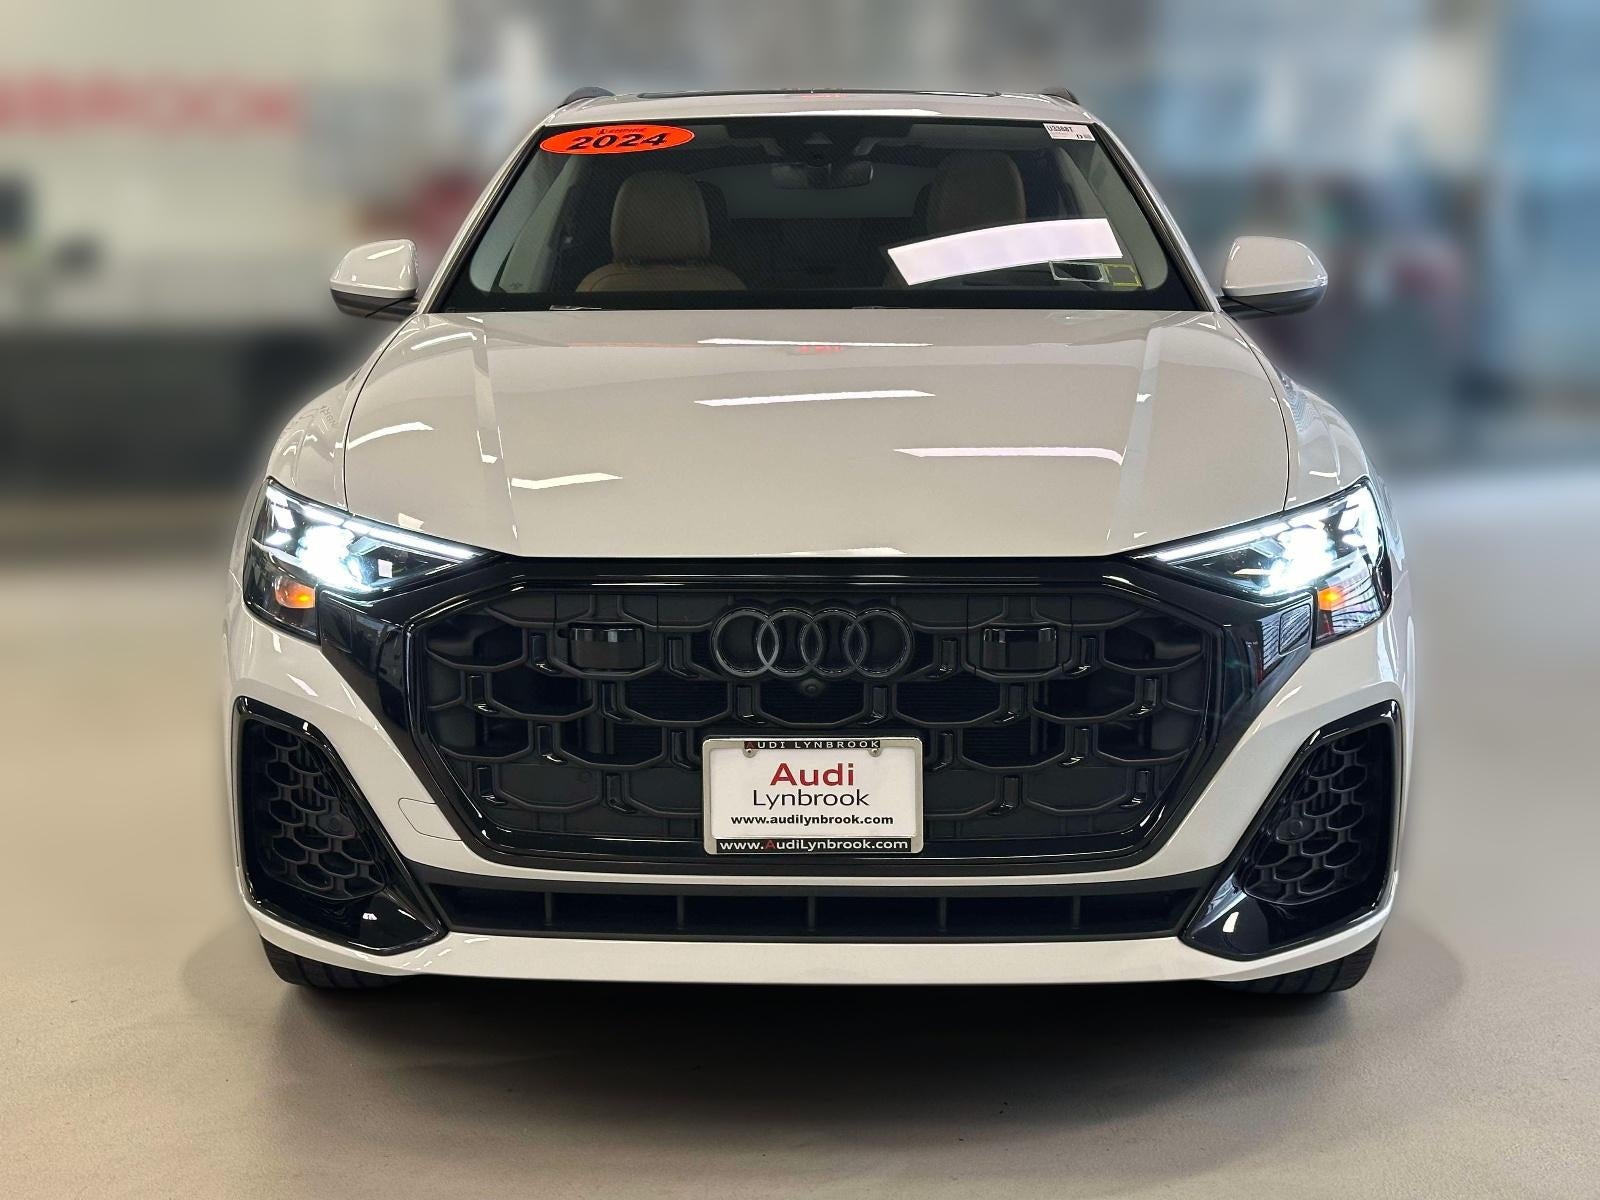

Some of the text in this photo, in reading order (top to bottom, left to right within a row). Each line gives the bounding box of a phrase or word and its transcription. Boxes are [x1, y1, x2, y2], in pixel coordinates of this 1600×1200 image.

[566, 132, 669, 151] 2024
[745, 740, 881, 749] AUDI LYNBROOK
[770, 762, 855, 786] Audi
[753, 789, 870, 810] Lynbrook
[731, 814, 894, 826] www.audilynbrook.com
[719, 839, 909, 852] www.AudiLynbrook.com
